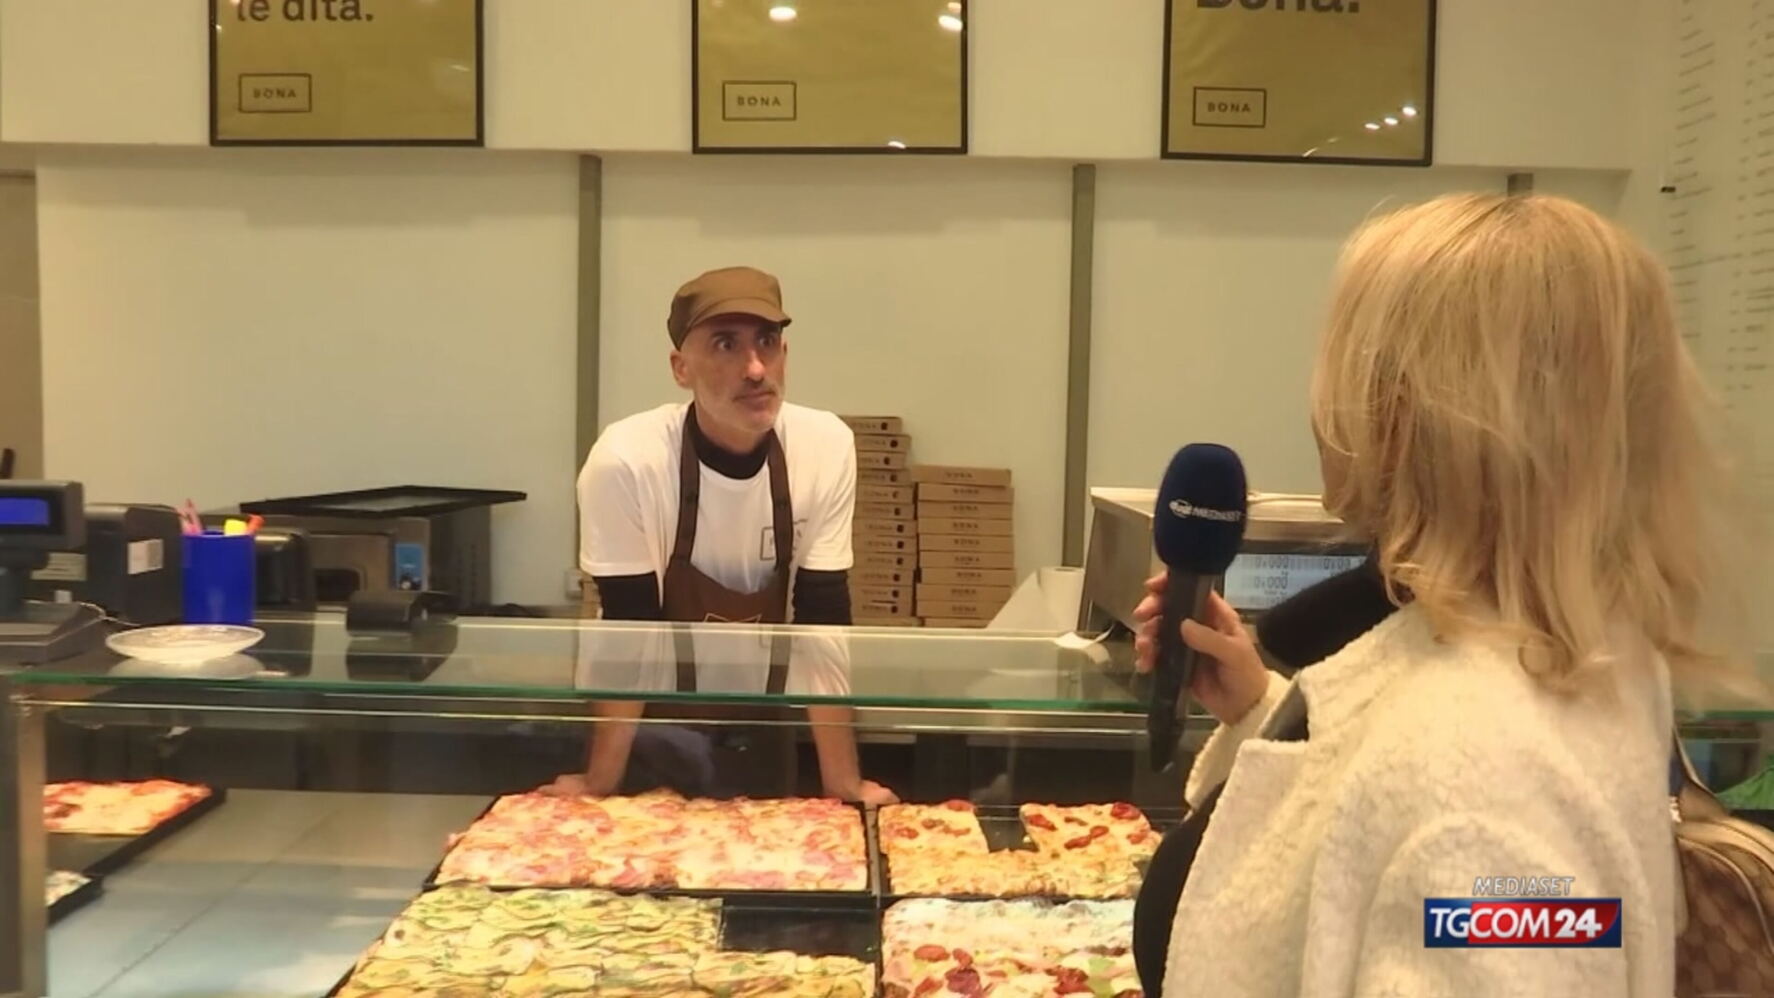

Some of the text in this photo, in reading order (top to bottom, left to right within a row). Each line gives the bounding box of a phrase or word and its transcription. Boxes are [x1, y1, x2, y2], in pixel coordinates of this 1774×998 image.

[282, 0, 374, 22] dita.
[253, 88, 297, 99] BONA
[737, 96, 782, 107] BONA
[1207, 102, 1252, 113] BONA
